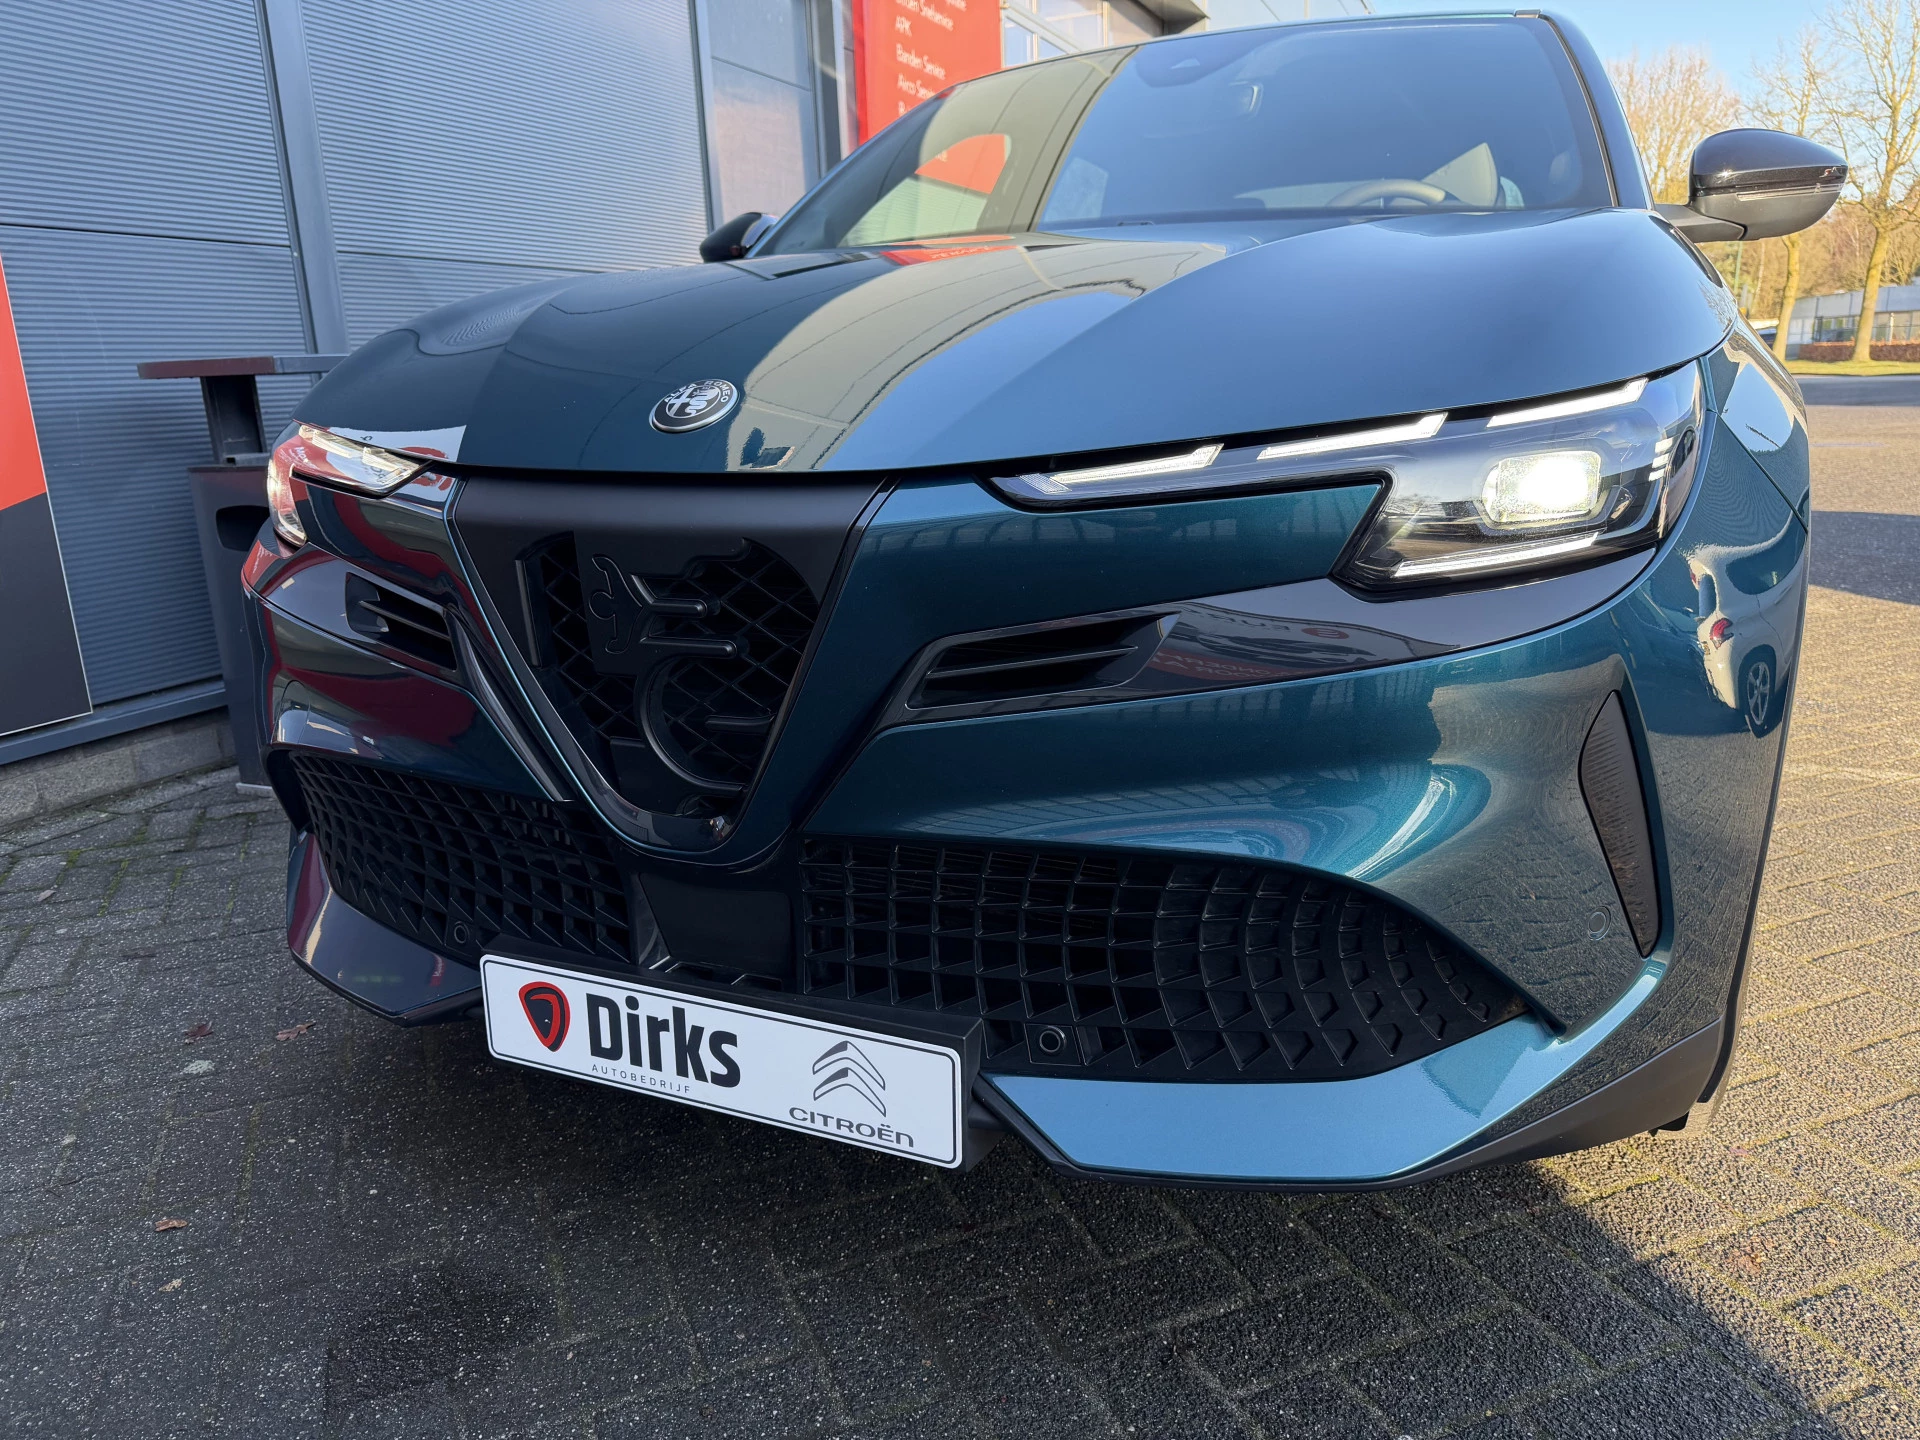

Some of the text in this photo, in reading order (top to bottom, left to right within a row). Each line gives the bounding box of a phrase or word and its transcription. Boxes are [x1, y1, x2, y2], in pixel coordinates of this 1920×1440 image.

[896, 43, 946, 80] Banden Service
[704, 380, 731, 403] ROMEO
[585, 993, 741, 1088] Dirks
[591, 1063, 691, 1094] AUTOBEDRIJF
[788, 1106, 914, 1148] CITROËN
